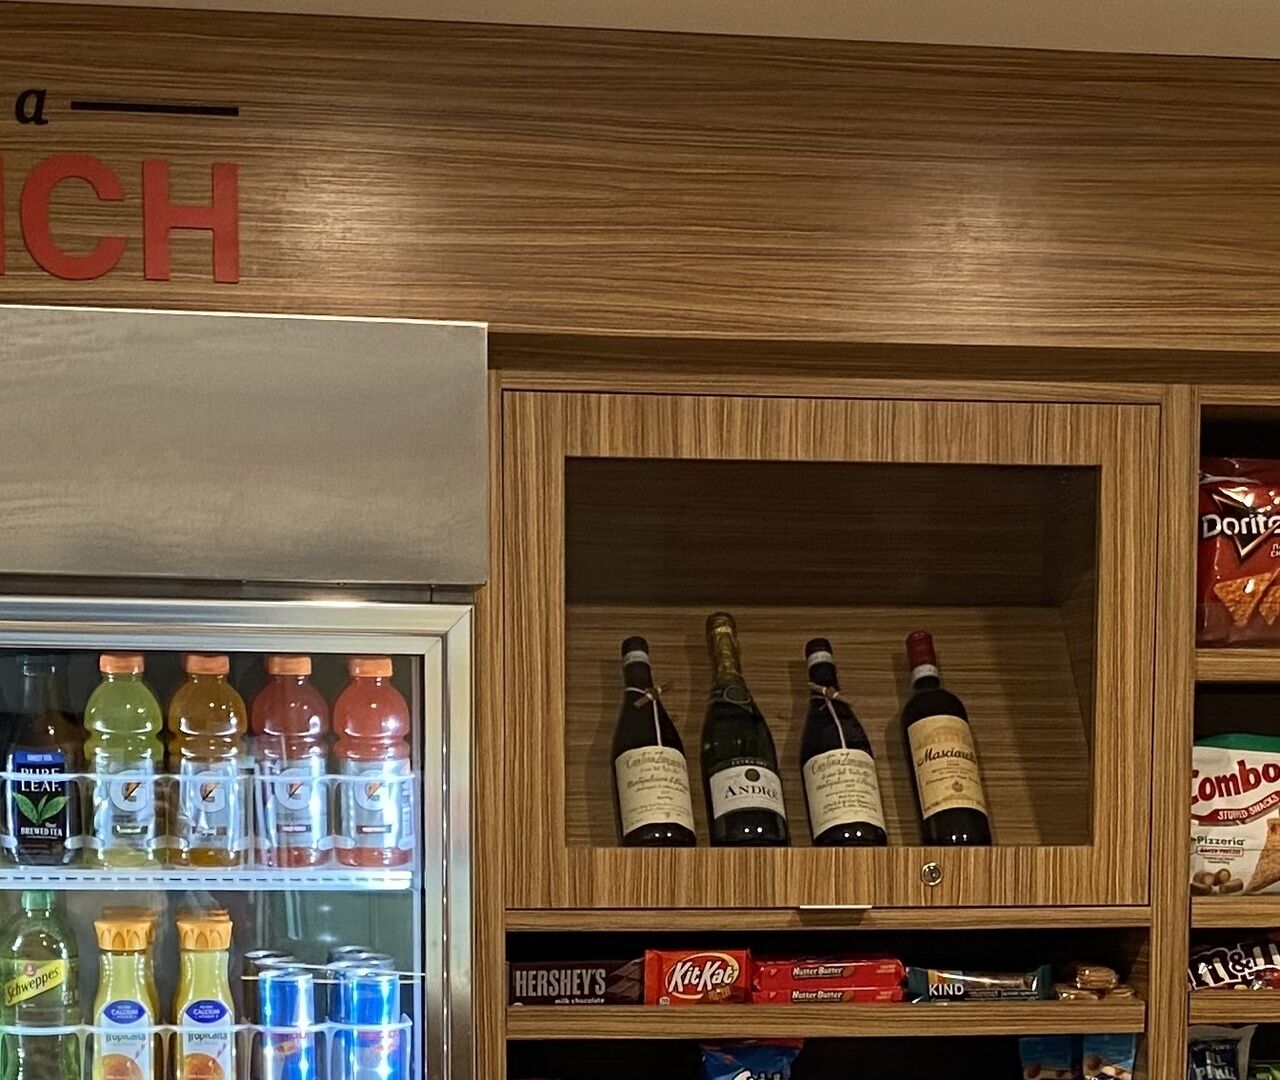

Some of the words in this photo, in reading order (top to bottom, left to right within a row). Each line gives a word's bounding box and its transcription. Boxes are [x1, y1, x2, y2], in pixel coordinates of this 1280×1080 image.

[14, 86, 49, 125] a
[1248, 793, 1280, 815] SNACKS
[20, 827, 46, 835] BREWED
[47, 828, 62, 836] TEA
[1197, 836, 1244, 847] Pizzeria
[792, 966, 818, 976] Nutter
[819, 967, 844, 976] Butter
[6, 967, 60, 1000] Schweppes
[515, 968, 606, 997] HERSHEY'S
[791, 990, 817, 1000] Nutter
[818, 991, 843, 1000] Butter
[928, 983, 964, 997] KIND
